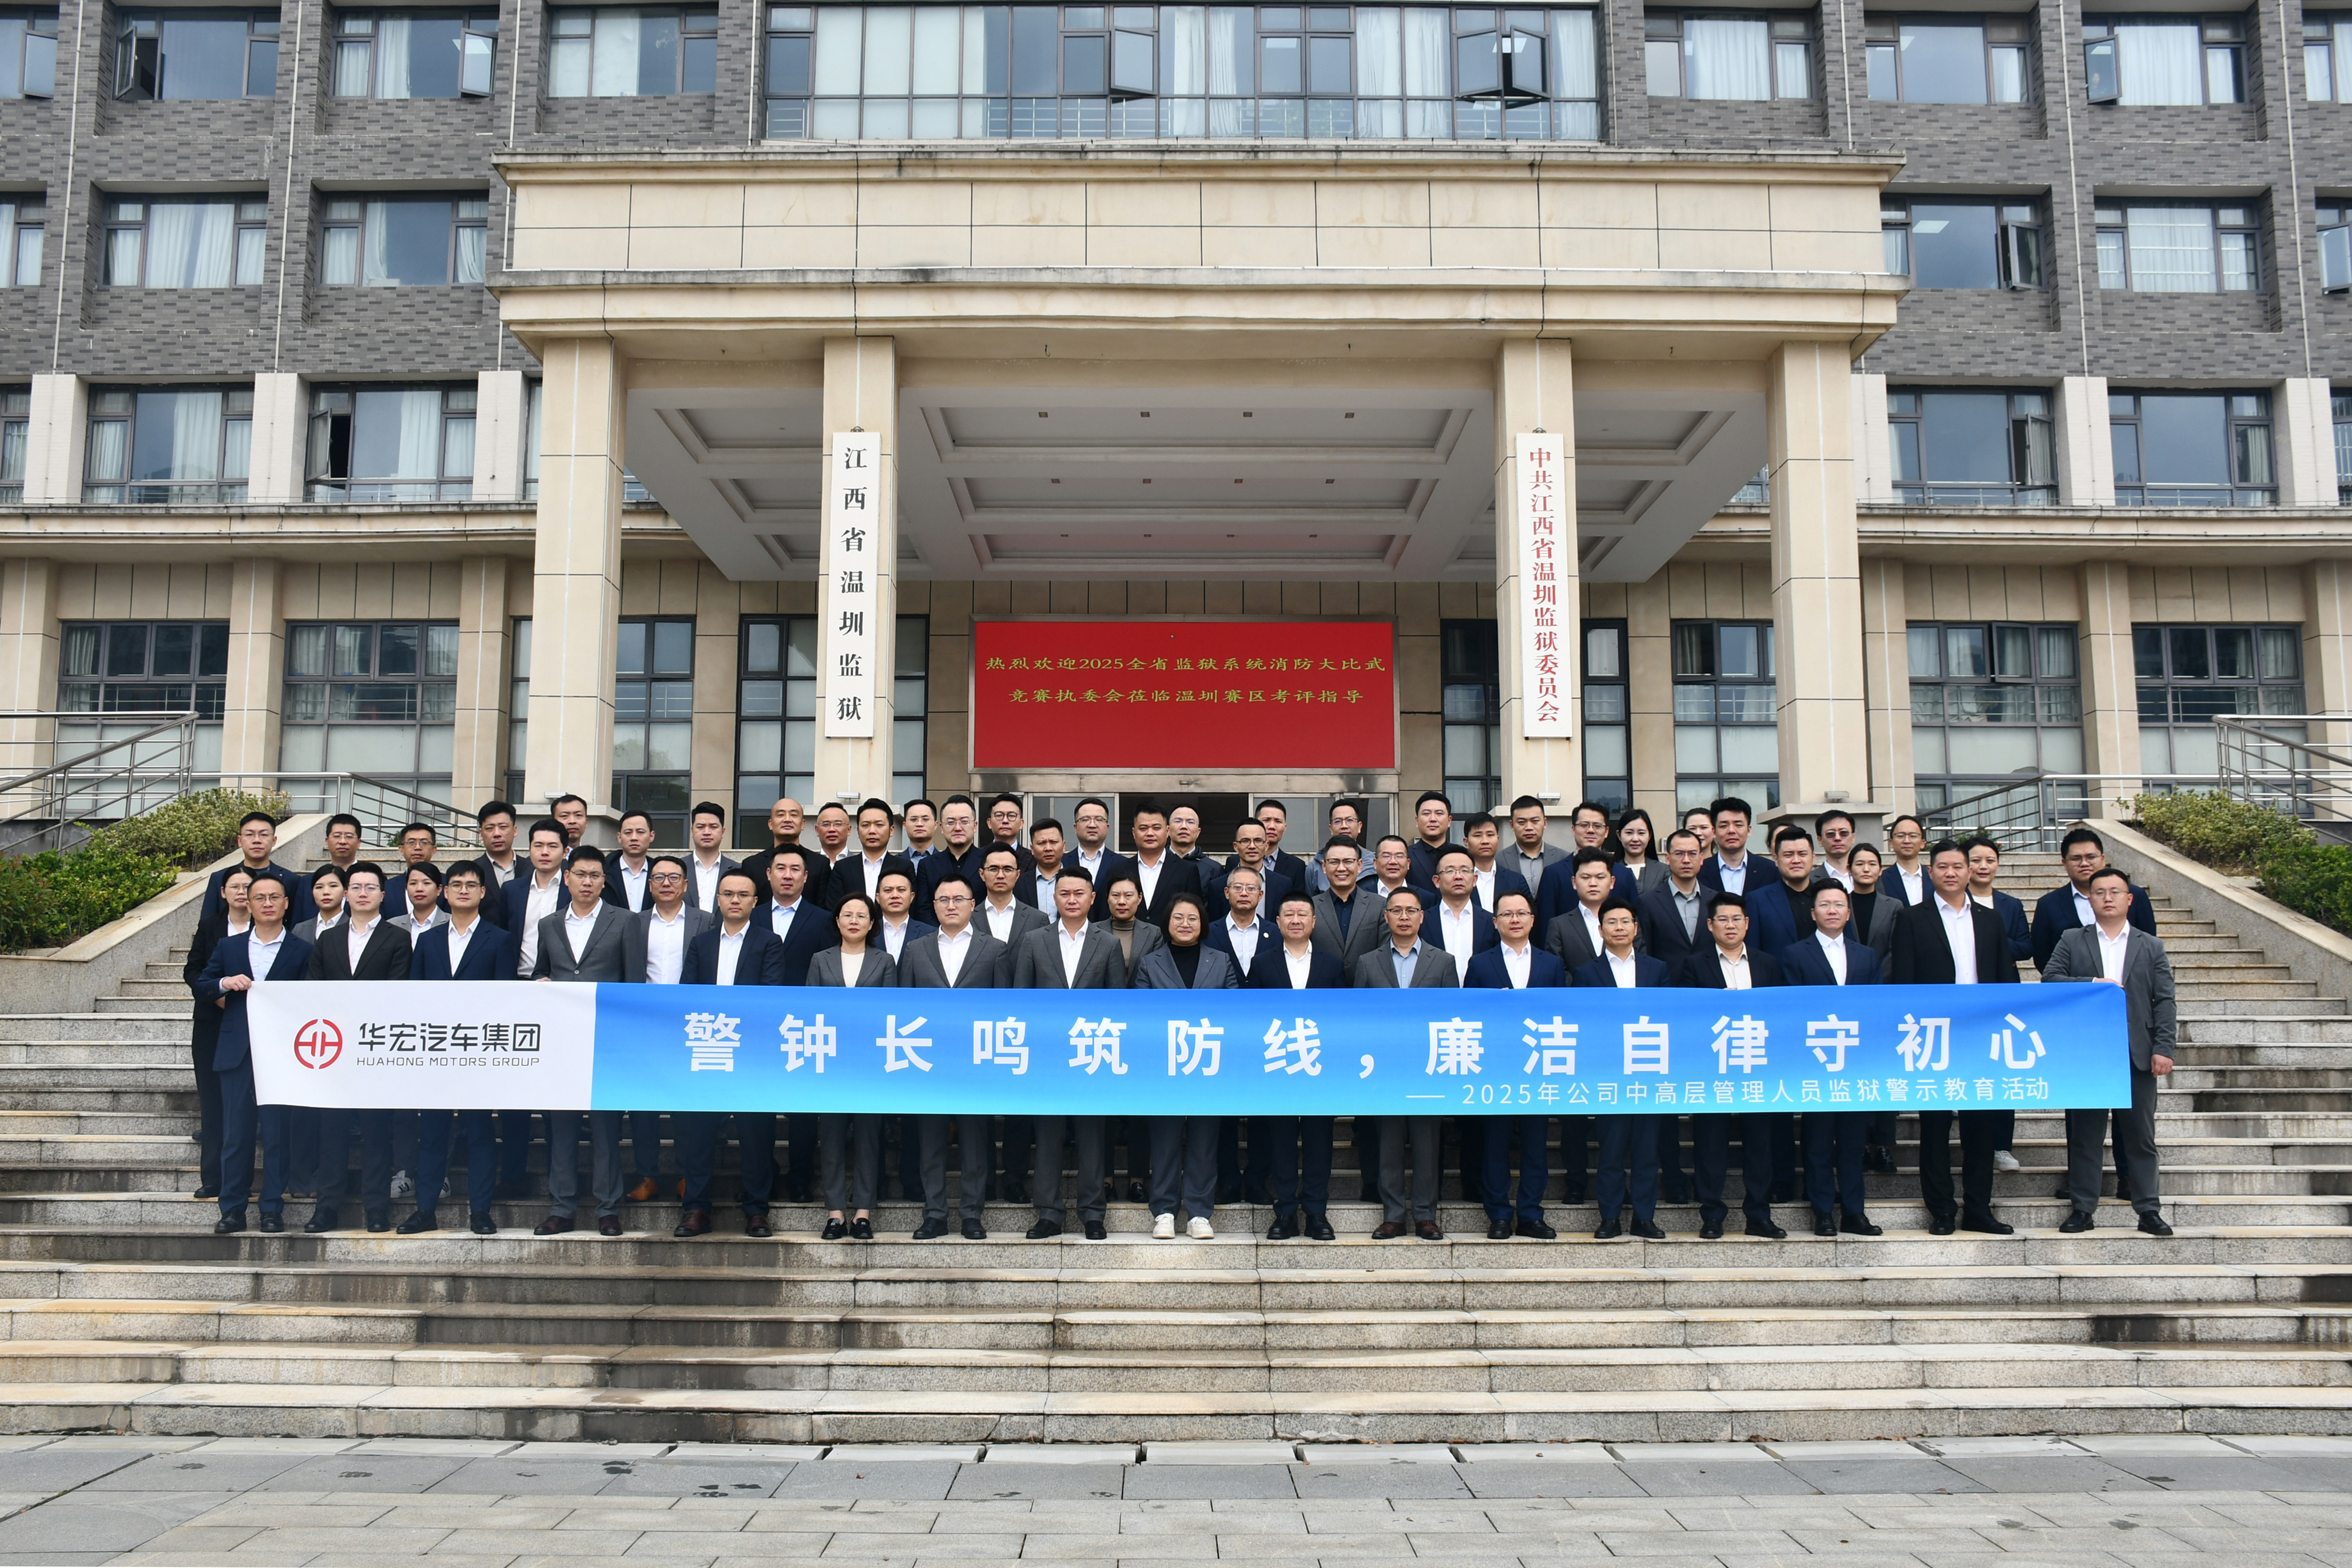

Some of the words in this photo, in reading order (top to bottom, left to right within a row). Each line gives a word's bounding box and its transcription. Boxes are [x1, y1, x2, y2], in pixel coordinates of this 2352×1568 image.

[836, 447, 868, 721] 江西省温圳监狱
[1528, 447, 1560, 723] 中共江西省温圳监狱委员会
[985, 656, 1386, 672] 热烈欢迎2025全省监狱系统消防大比武
[1008, 689, 1364, 704] 竞赛执委会莅临温圳赛区考评指导
[358, 1022, 541, 1052] 华宏汽车集团
[357, 1057, 423, 1066] HUAHONG
[430, 1057, 486, 1066] MOTORS
[492, 1057, 539, 1066] GROUP
